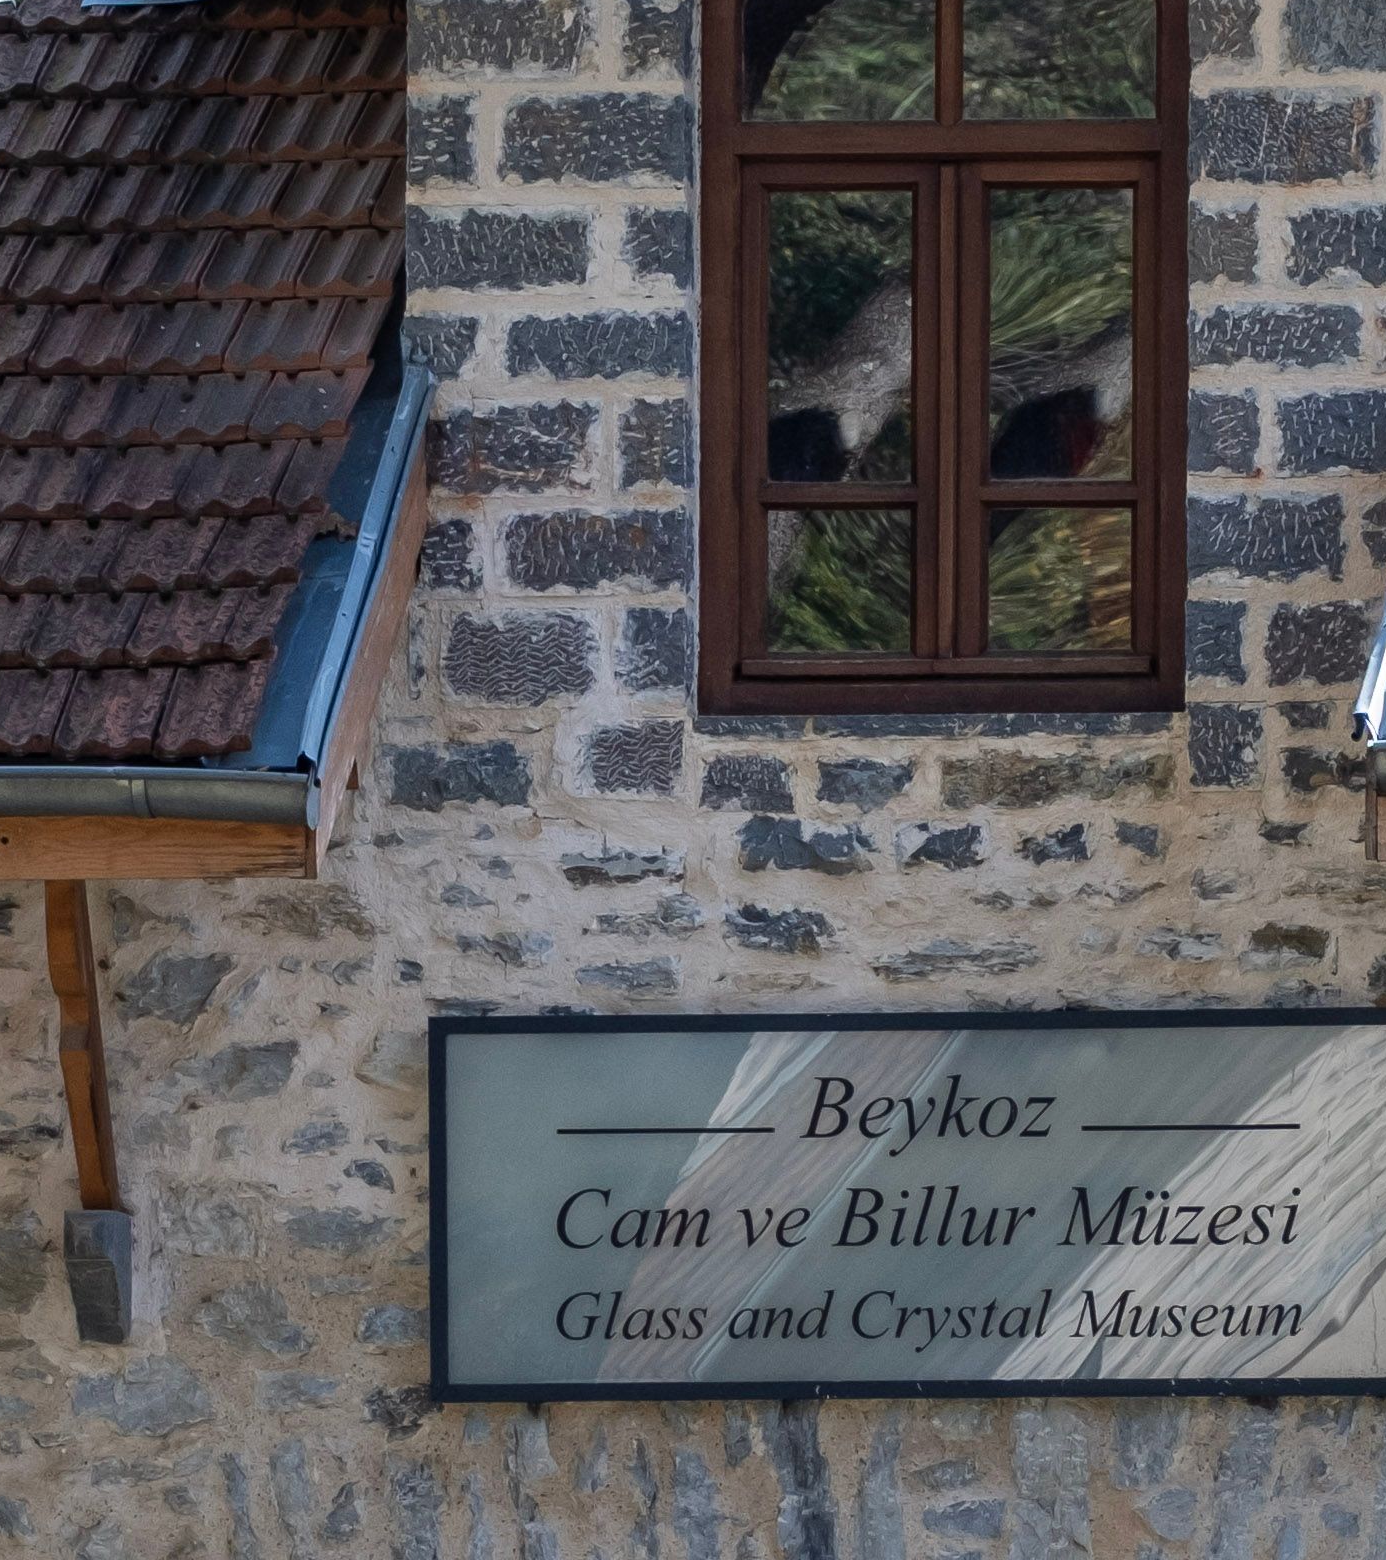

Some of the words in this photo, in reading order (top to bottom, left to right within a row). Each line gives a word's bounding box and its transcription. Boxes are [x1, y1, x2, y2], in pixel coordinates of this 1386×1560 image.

[799, 1074, 1056, 1156] Beykoz
[555, 1187, 711, 1250] Cam
[738, 1201, 811, 1250] ve
[832, 1186, 1036, 1249] Billur
[1057, 1186, 1303, 1248] Müzesi
[555, 1289, 708, 1341] Glass
[729, 1288, 836, 1340] and
[850, 1288, 1052, 1355] Crystal
[1070, 1289, 1305, 1339] Museum
